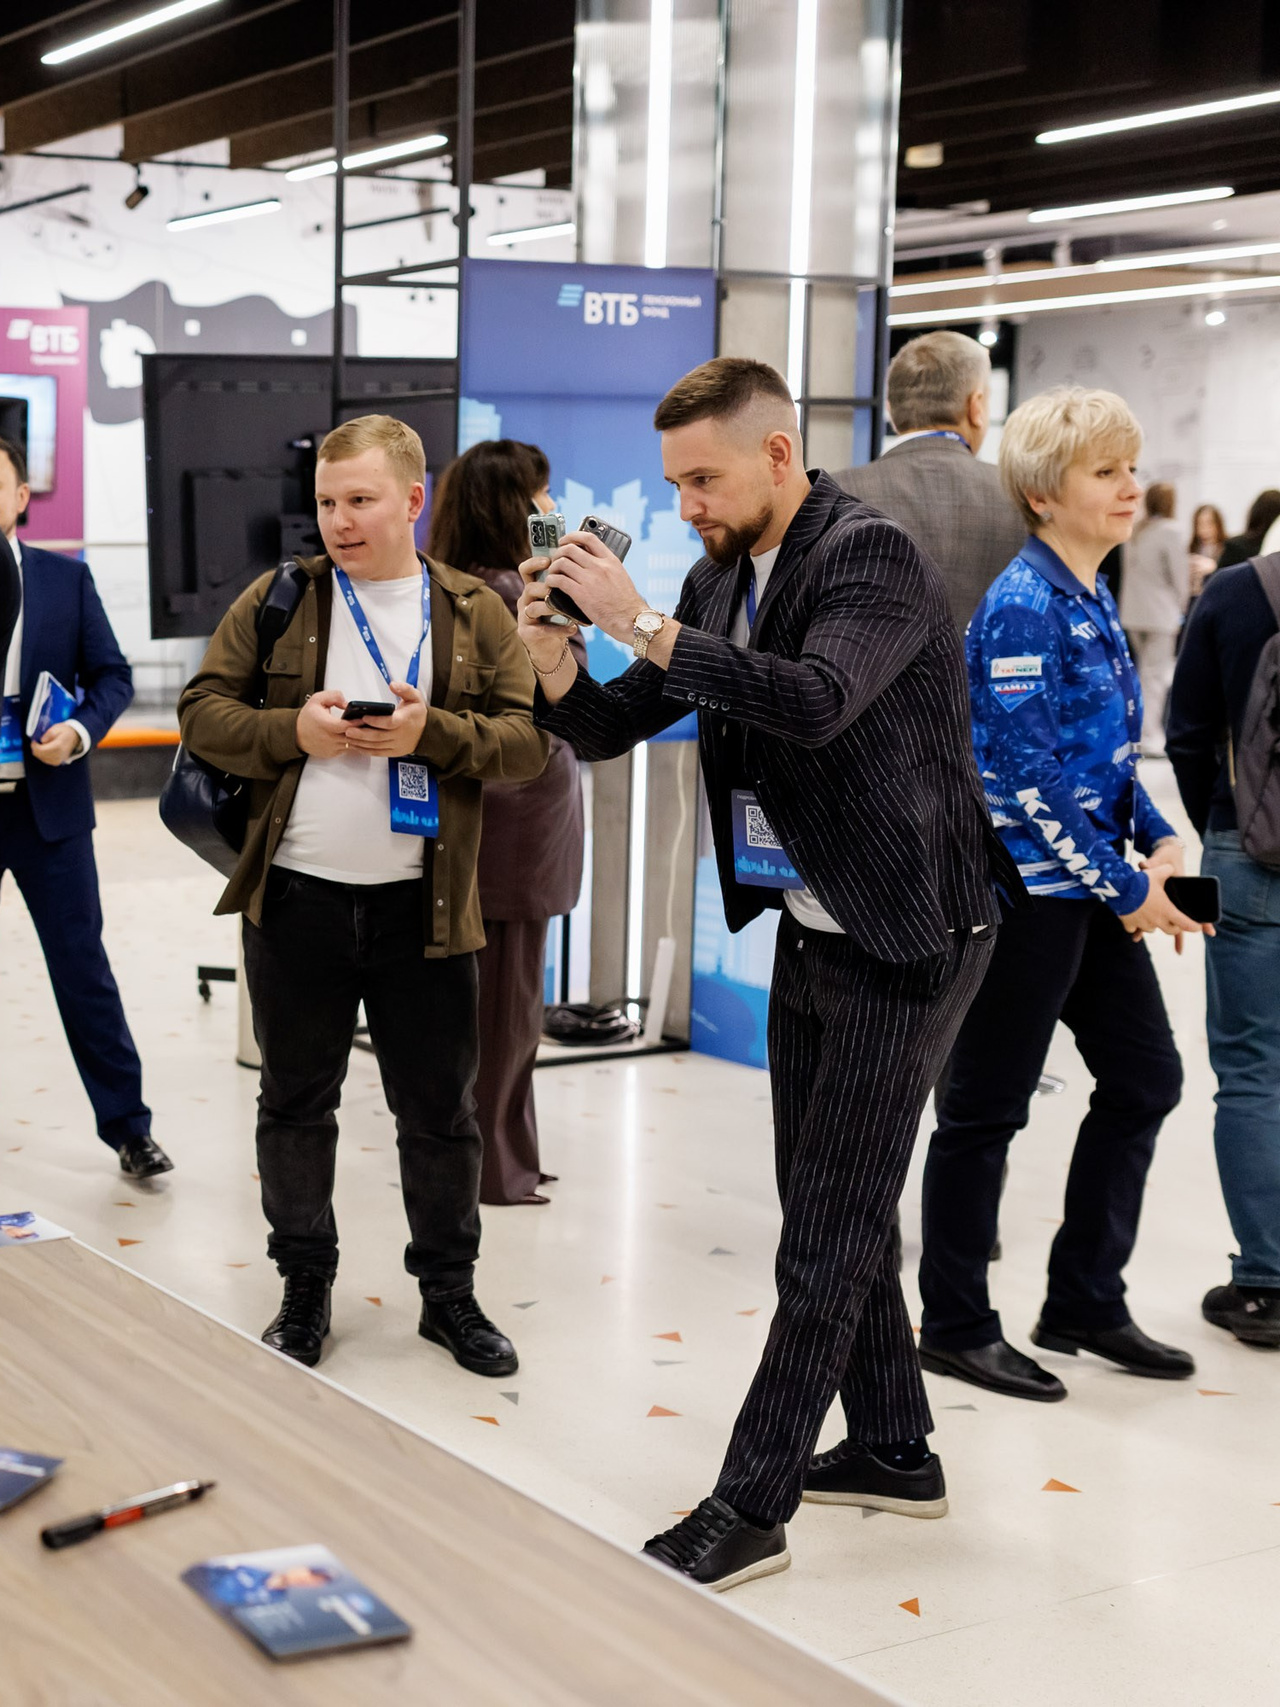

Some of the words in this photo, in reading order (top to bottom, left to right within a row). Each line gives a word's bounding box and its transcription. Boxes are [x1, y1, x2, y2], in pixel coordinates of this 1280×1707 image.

[583, 291, 640, 326] ВТБ
[29, 325, 80, 354] ВТБ
[1016, 786, 1121, 902] KAMAZ
